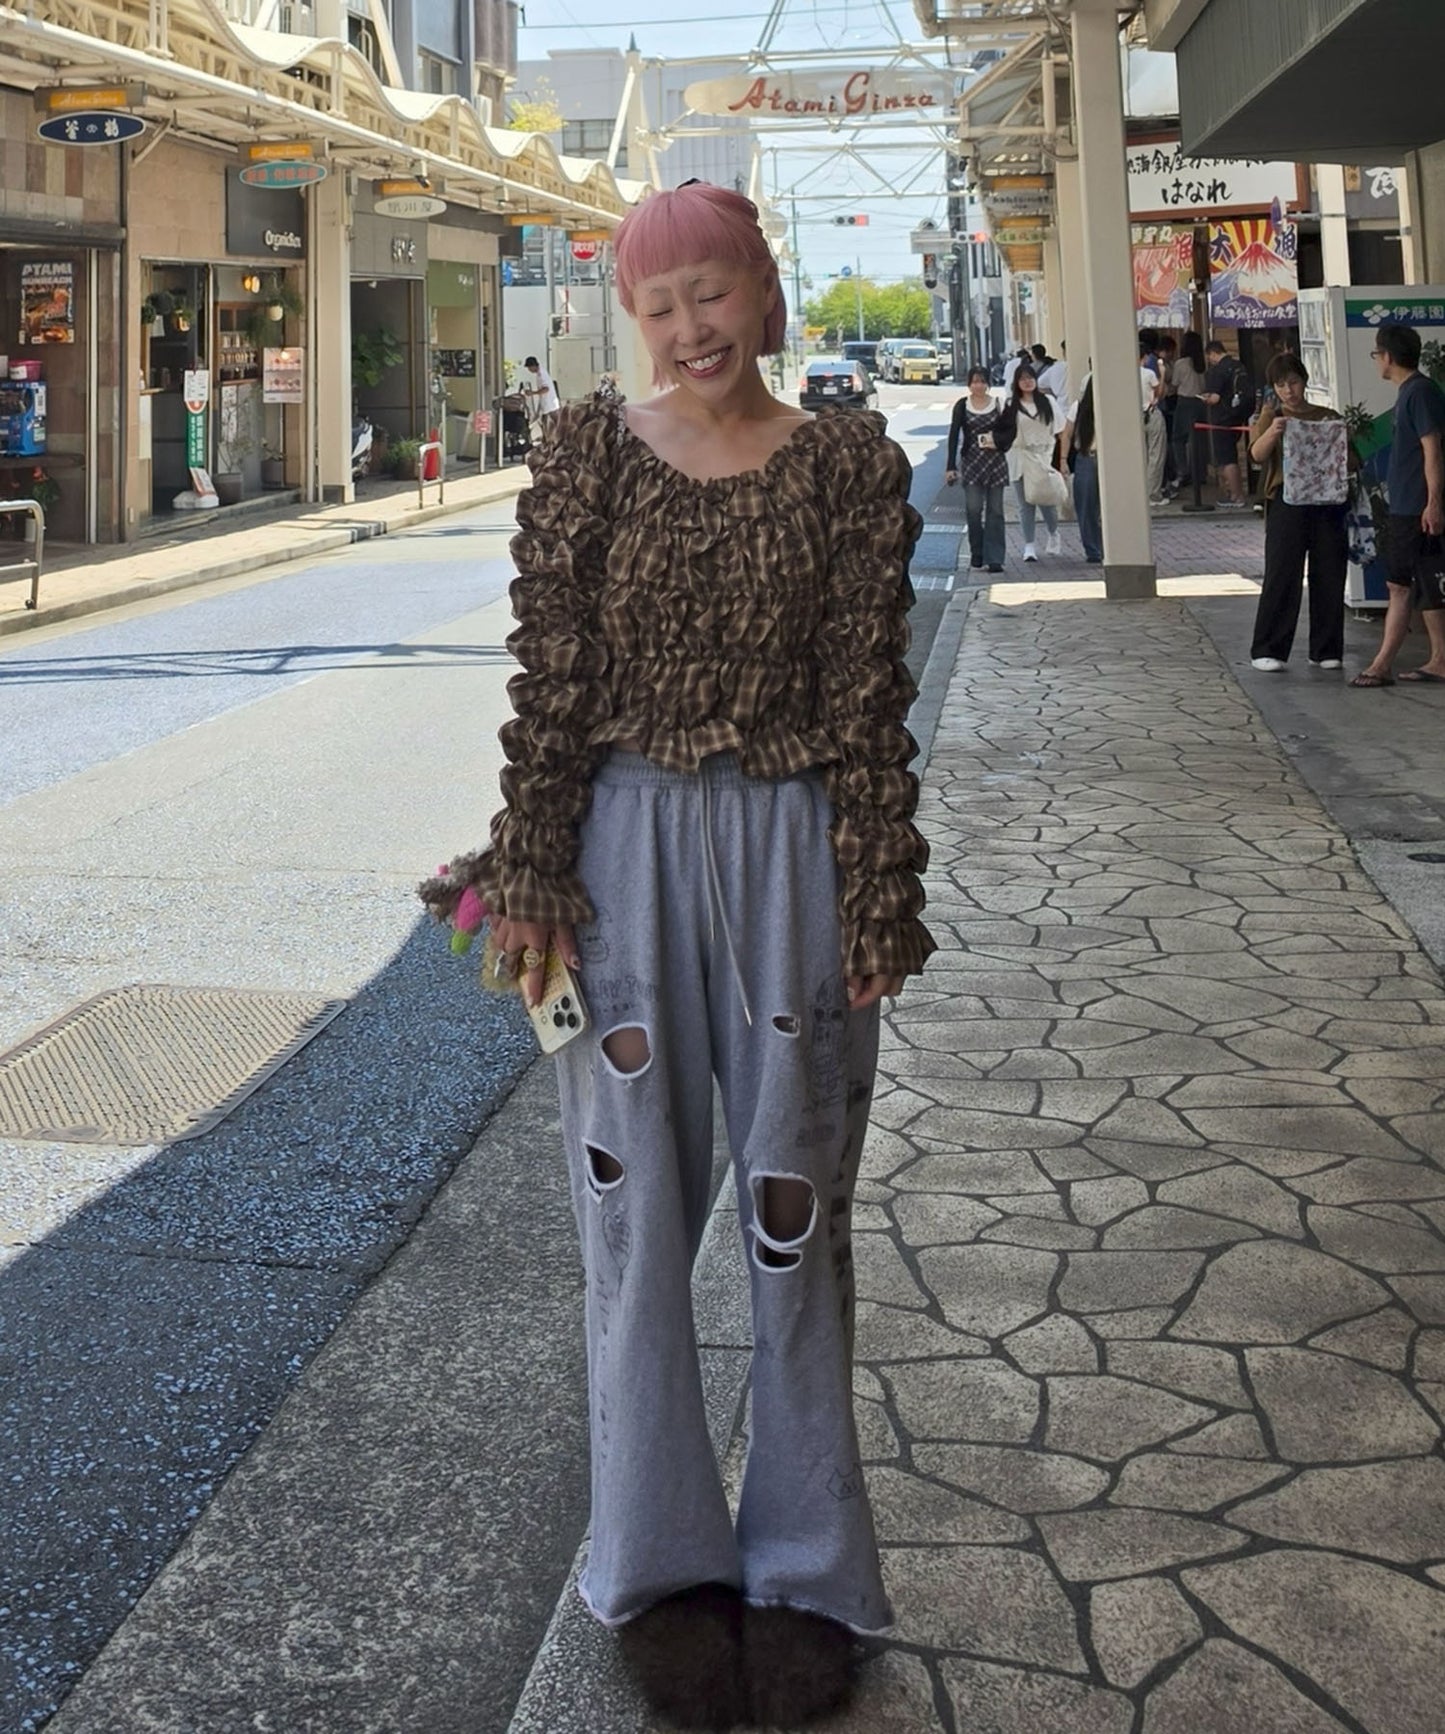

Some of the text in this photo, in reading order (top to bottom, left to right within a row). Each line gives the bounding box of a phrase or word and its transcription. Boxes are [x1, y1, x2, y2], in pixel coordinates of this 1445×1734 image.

[729, 71, 936, 115] Atami Ginza
[1161, 178, 1233, 204] はなれ
[1210, 226, 1231, 262] 大
[21, 263, 73, 276] ATAMI
[1392, 305, 1445, 320] 伊藤園
